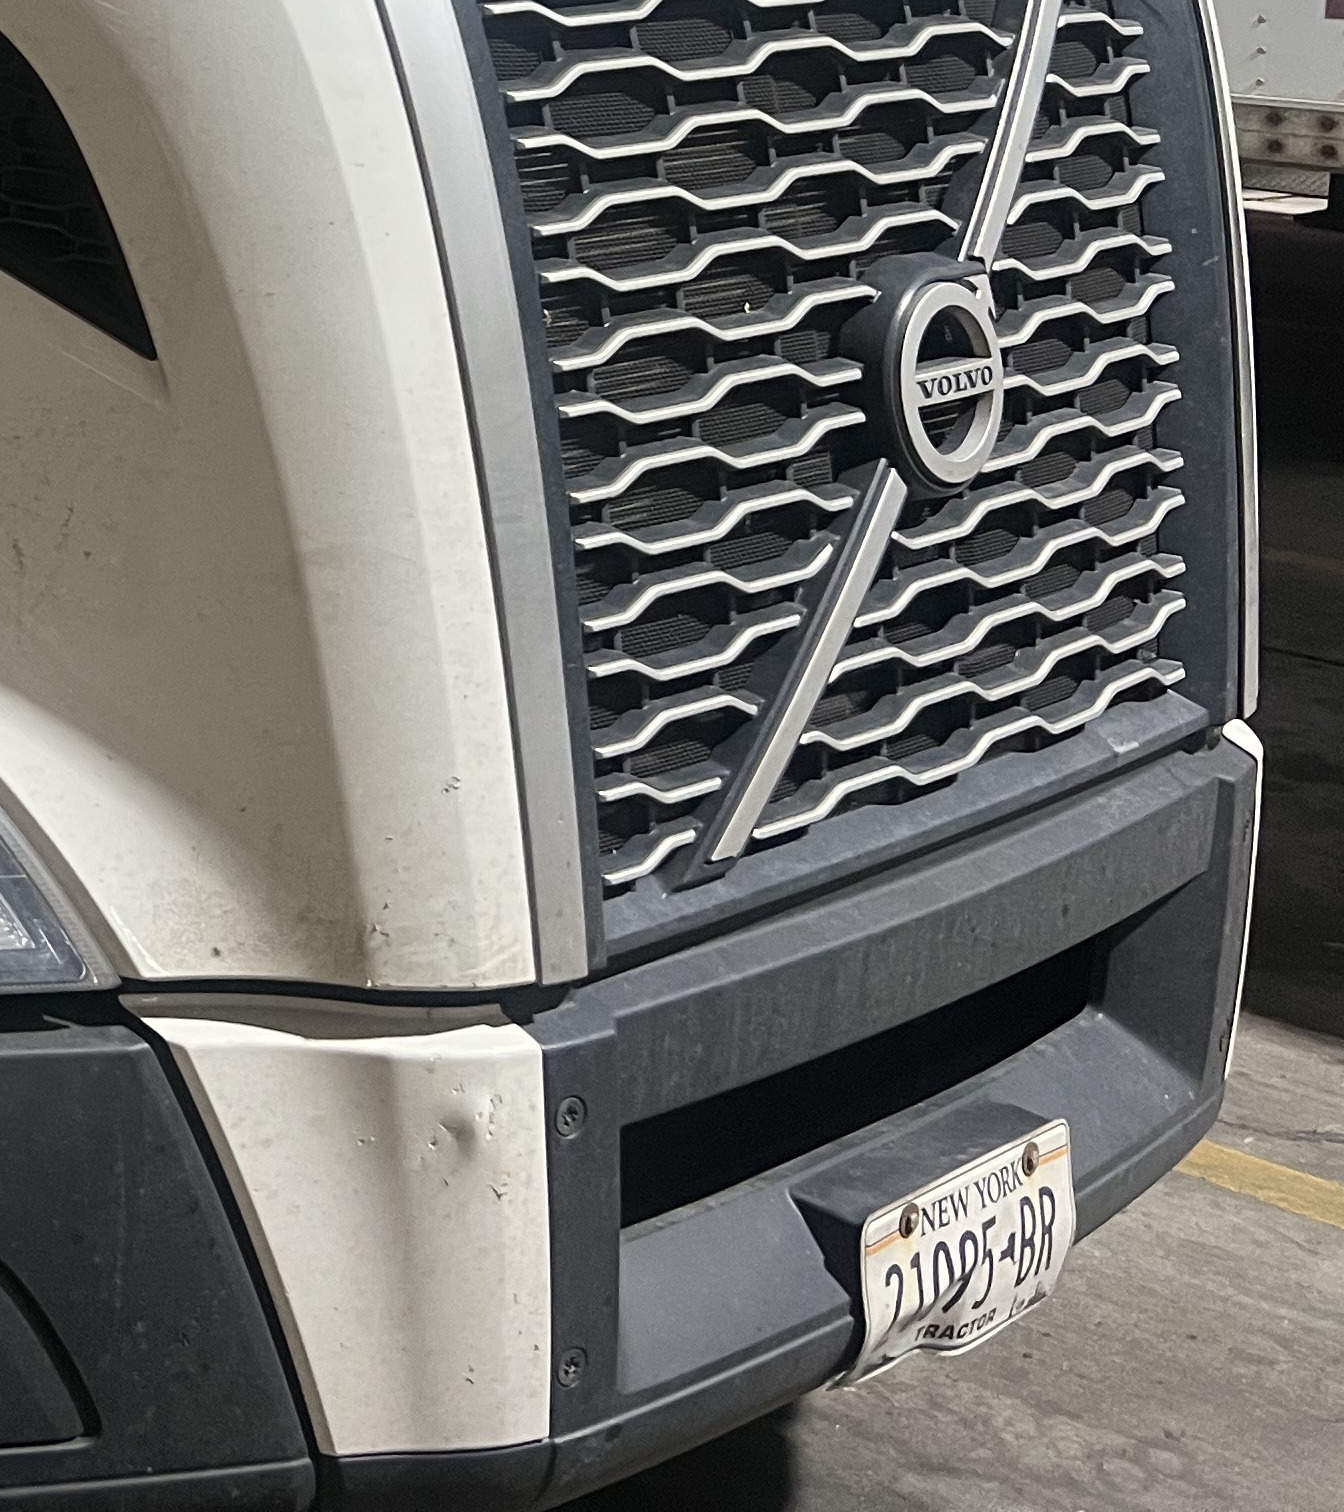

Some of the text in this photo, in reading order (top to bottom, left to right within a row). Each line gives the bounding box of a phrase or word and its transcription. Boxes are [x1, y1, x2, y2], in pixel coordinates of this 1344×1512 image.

[915, 365, 994, 400] VOLVO
[919, 1159, 1024, 1237] NEW YORK
[914, 1307, 998, 1341] TRACTOR
